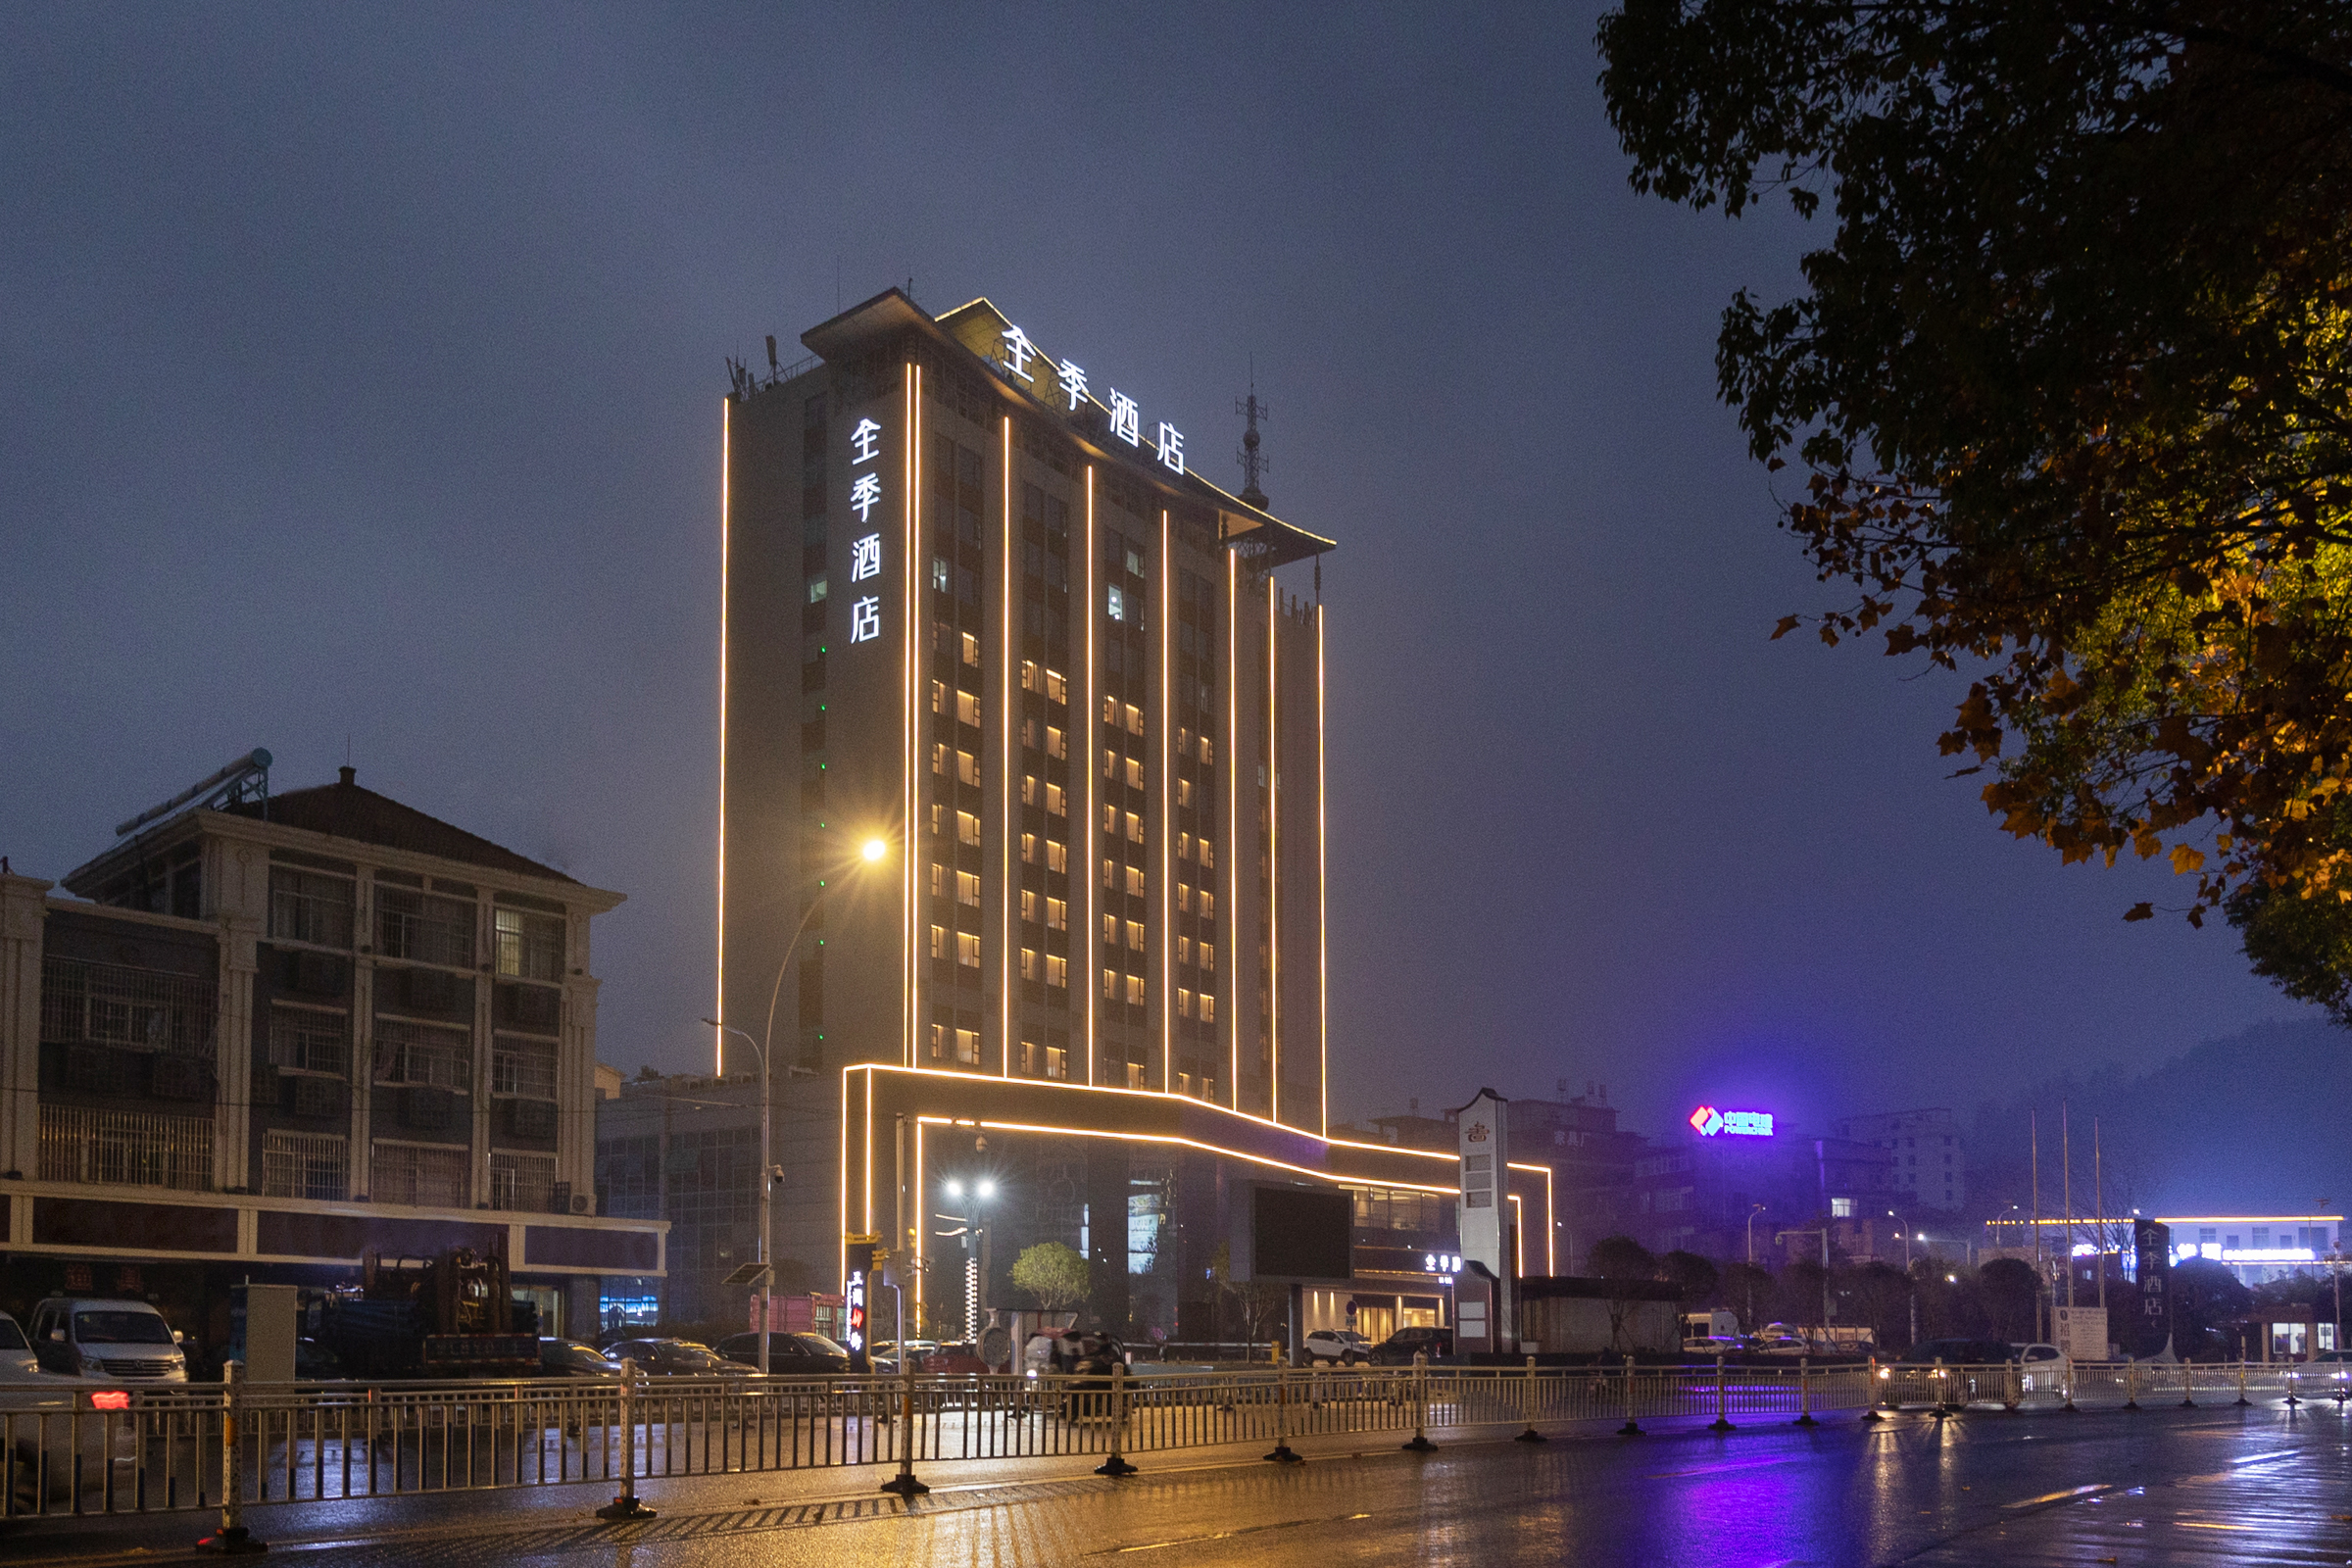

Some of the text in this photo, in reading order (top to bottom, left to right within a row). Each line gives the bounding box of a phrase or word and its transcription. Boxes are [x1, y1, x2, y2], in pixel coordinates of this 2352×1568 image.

[1002, 324, 1185, 475] 全季酒店
[850, 417, 881, 645] 全季酒店
[2141, 1228, 2163, 1316] 全季酒店
